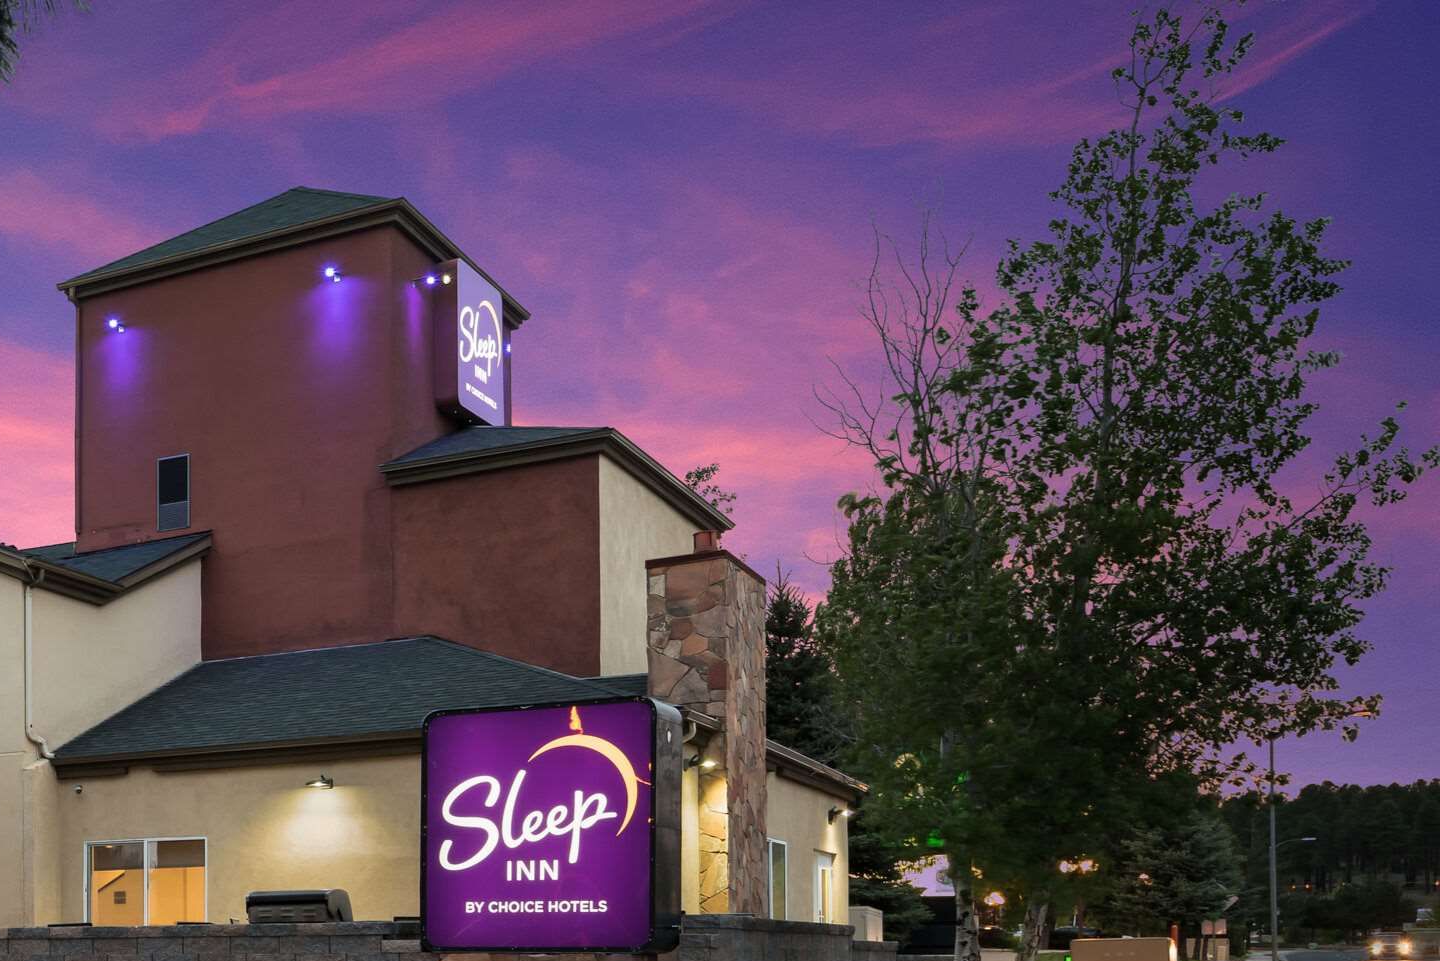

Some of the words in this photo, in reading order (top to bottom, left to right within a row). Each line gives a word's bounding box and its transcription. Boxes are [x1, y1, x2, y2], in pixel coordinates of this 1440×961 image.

[460, 305, 498, 377] Sleep
[438, 769, 618, 871] Sleep
[506, 859, 559, 881] INN
[465, 901, 484, 913] BY
[488, 901, 544, 913] CHOICE
[548, 900, 608, 913] HOTELS
